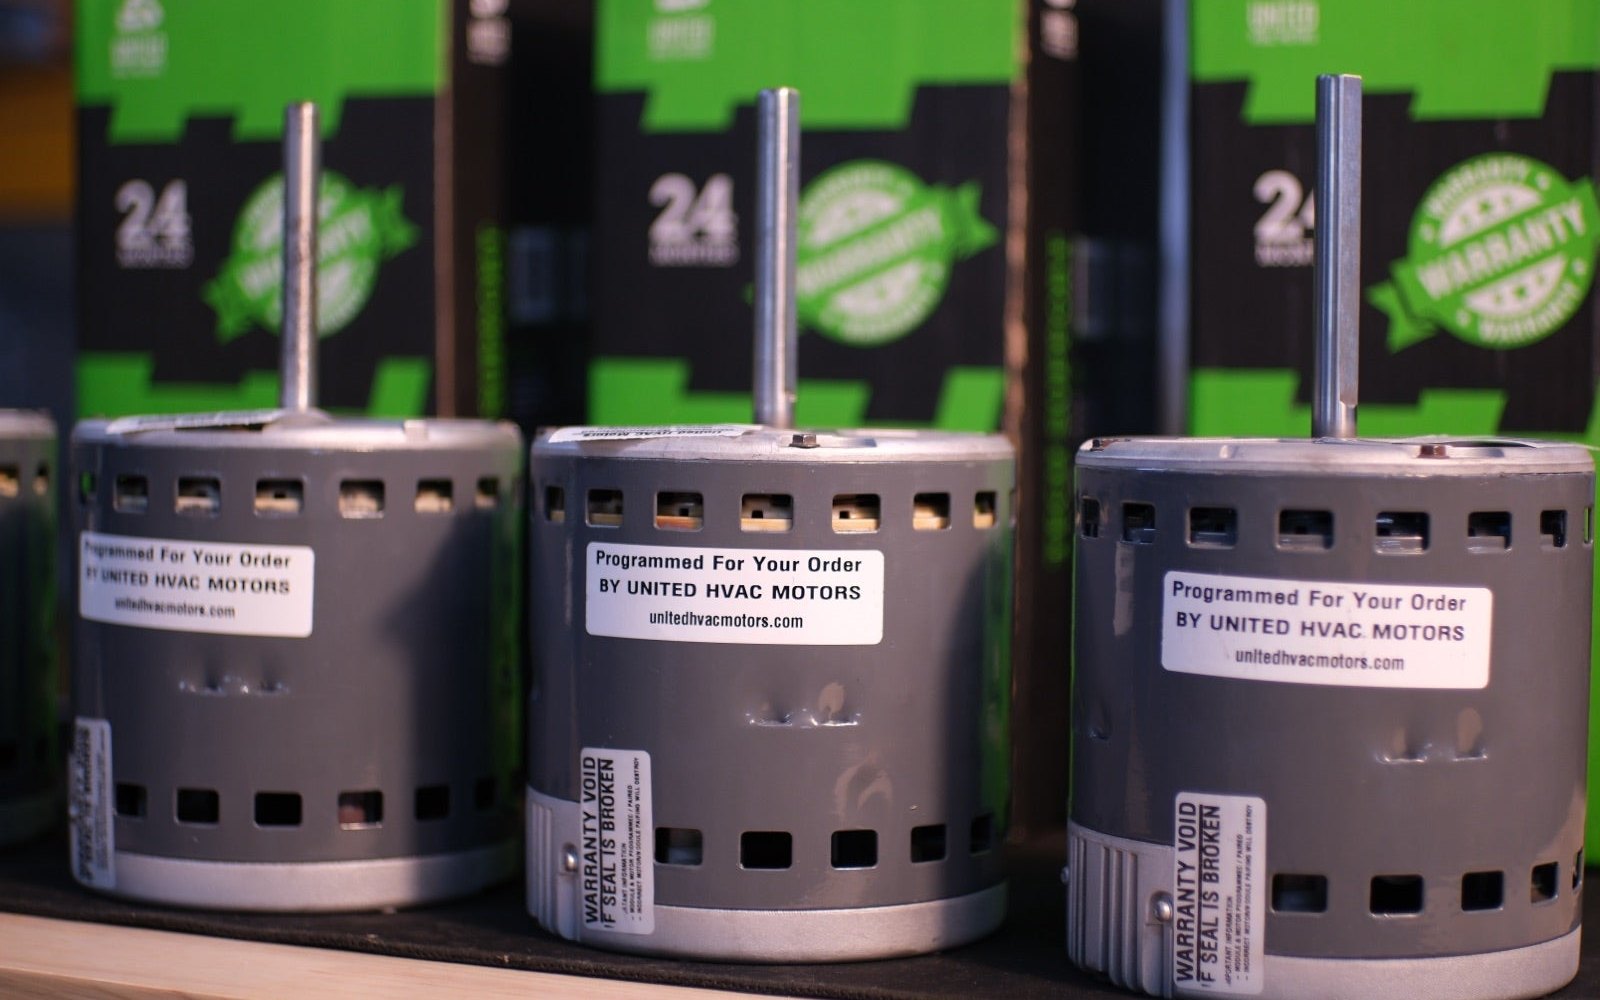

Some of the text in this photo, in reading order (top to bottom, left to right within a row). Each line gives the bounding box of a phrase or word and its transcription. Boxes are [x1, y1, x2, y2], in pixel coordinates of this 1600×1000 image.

[115, 177, 190, 243] 24
[648, 171, 737, 243] 24
[1416, 198, 1585, 299] WARRANTY
[161, 548, 185, 563] For
[193, 550, 232, 567] Your
[240, 552, 291, 568] Order
[596, 550, 862, 572] Programmed For Your Order
[102, 569, 148, 585] UNITED
[155, 574, 200, 590] HVAC
[208, 577, 290, 594] MOTORS
[600, 578, 861, 600] BY UNITED HVAC MOTORS
[1173, 581, 1467, 611] Programmed For Your Order
[649, 611, 803, 628] unitedhvacmotors.com
[1176, 611, 1465, 641] BY UNITED HVAC MOTORS
[1235, 648, 1405, 670] unitedhvacmotors.com
[600, 759, 614, 831] BROKEN
[583, 757, 597, 923] WARRANTY VOID
[602, 839, 615, 855] IS
[1202, 806, 1220, 883] BROKEN
[602, 863, 616, 906] SEAL
[1176, 803, 1196, 981] WARRANTY VOID
[1202, 892, 1219, 909] IS
[1201, 918, 1218, 964] SEAL
